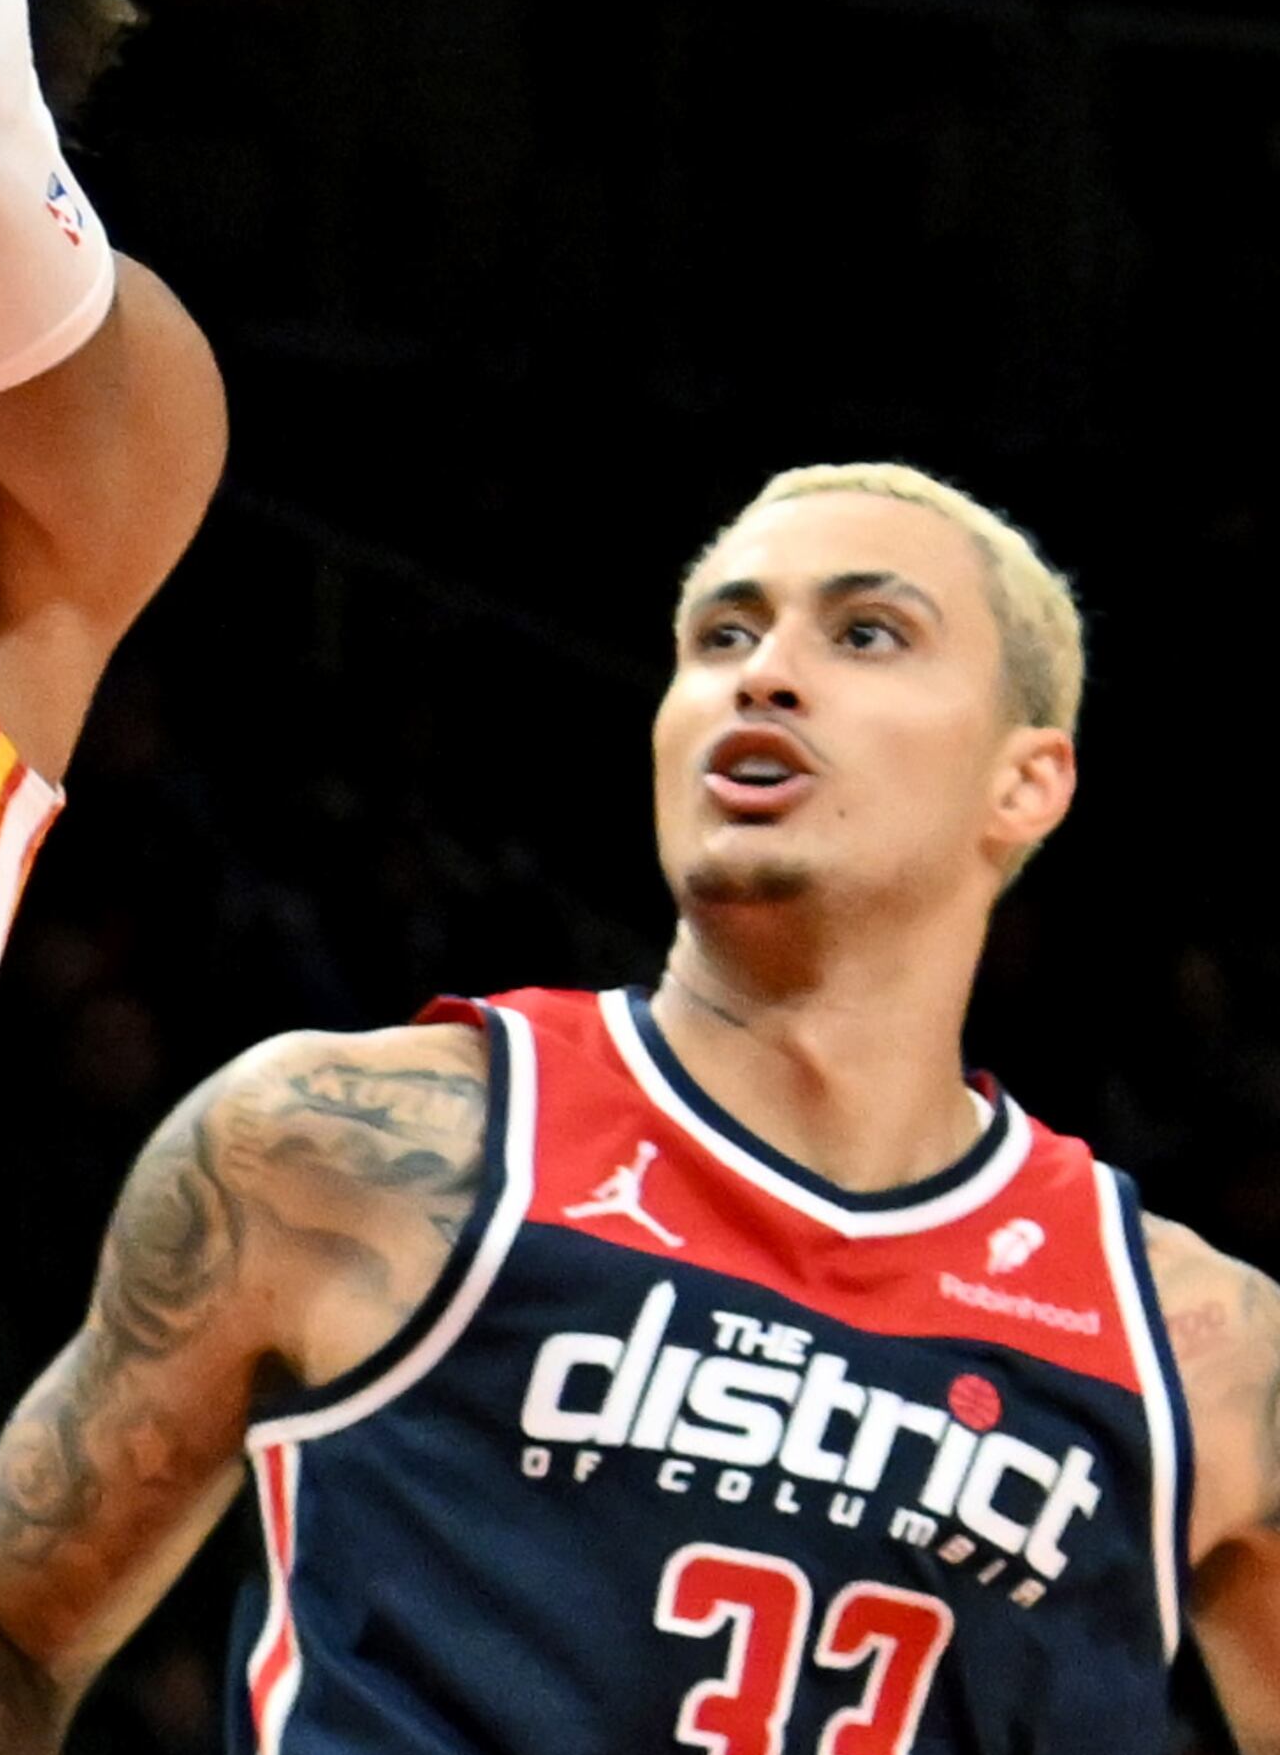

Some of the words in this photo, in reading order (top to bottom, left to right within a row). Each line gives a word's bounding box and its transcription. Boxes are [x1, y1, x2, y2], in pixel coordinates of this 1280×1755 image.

[711, 1309, 812, 1365] THE
[520, 1280, 1103, 1581] district
[520, 1448, 602, 1483] OF
